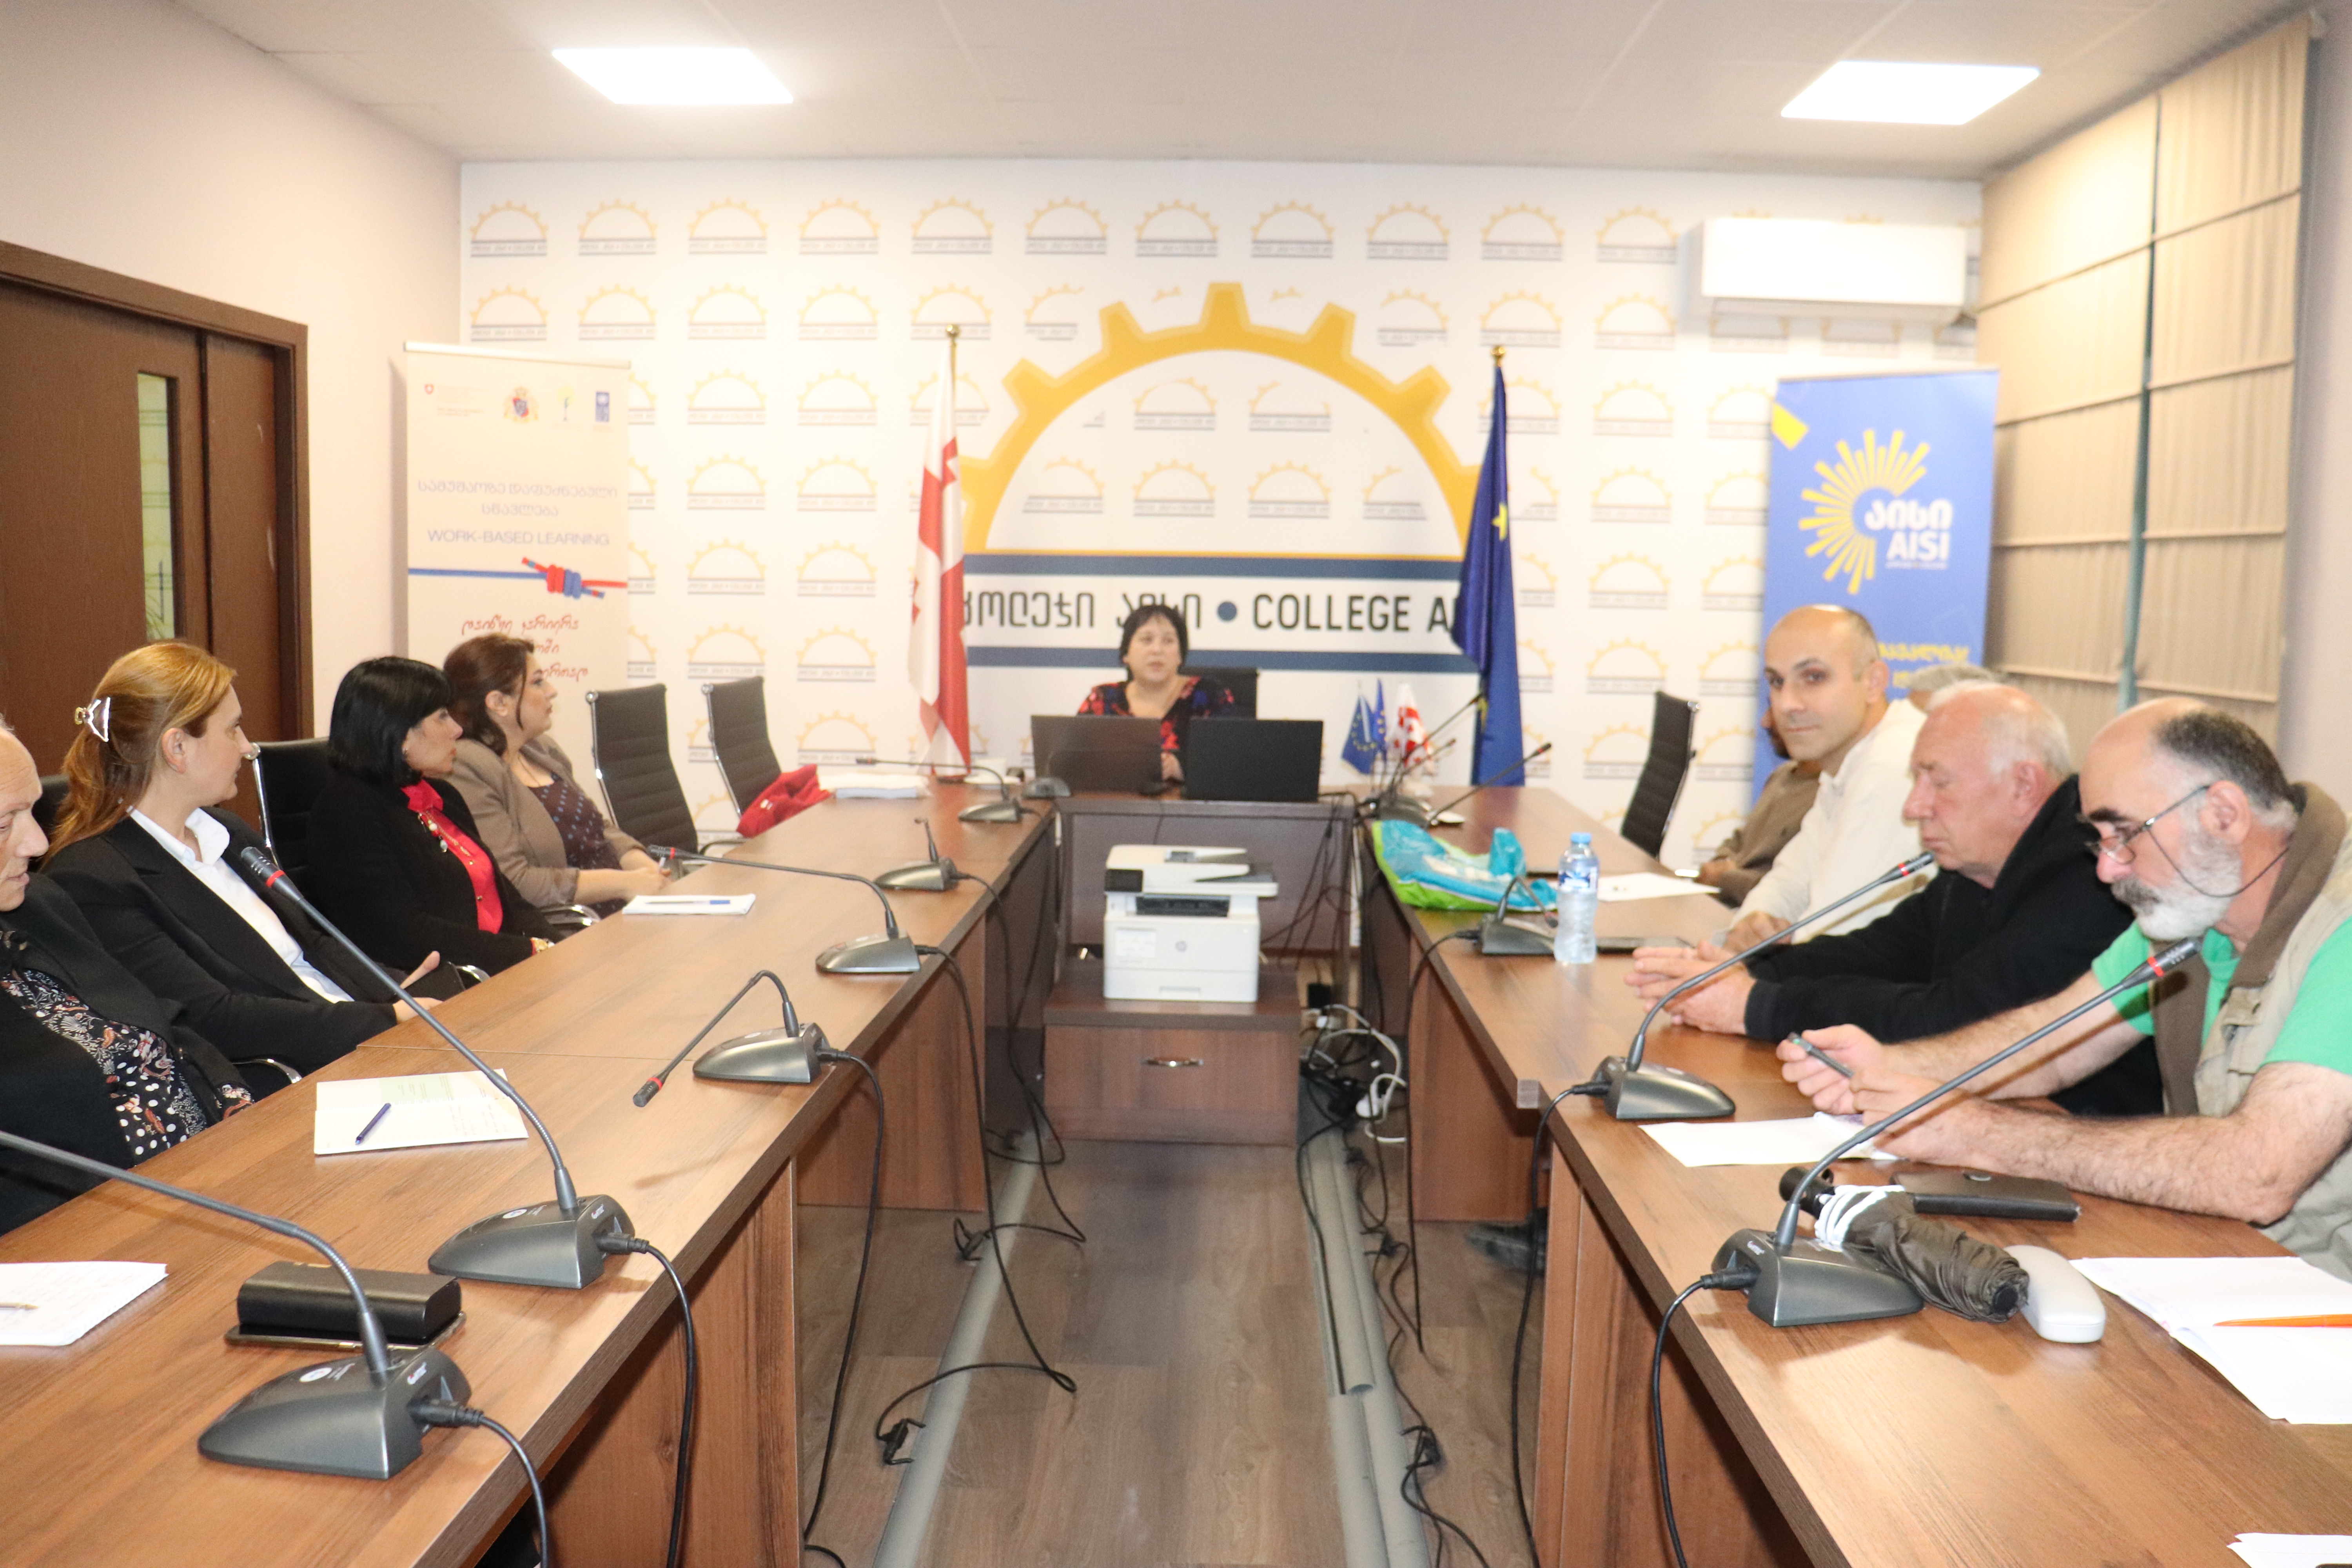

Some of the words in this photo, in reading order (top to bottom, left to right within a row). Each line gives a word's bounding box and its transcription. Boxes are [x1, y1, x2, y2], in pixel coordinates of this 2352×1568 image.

[418, 480, 505, 494] სამუშაოზე
[509, 483, 618, 499] დაფუძნებული
[482, 503, 559, 517] სწავლება
[1865, 499, 1952, 530] აისი
[428, 530, 533, 544] WORK-BASED
[537, 532, 610, 546] LEARNING
[1886, 531, 1949, 561] AISI
[1253, 593, 1410, 632] COLLEGE
